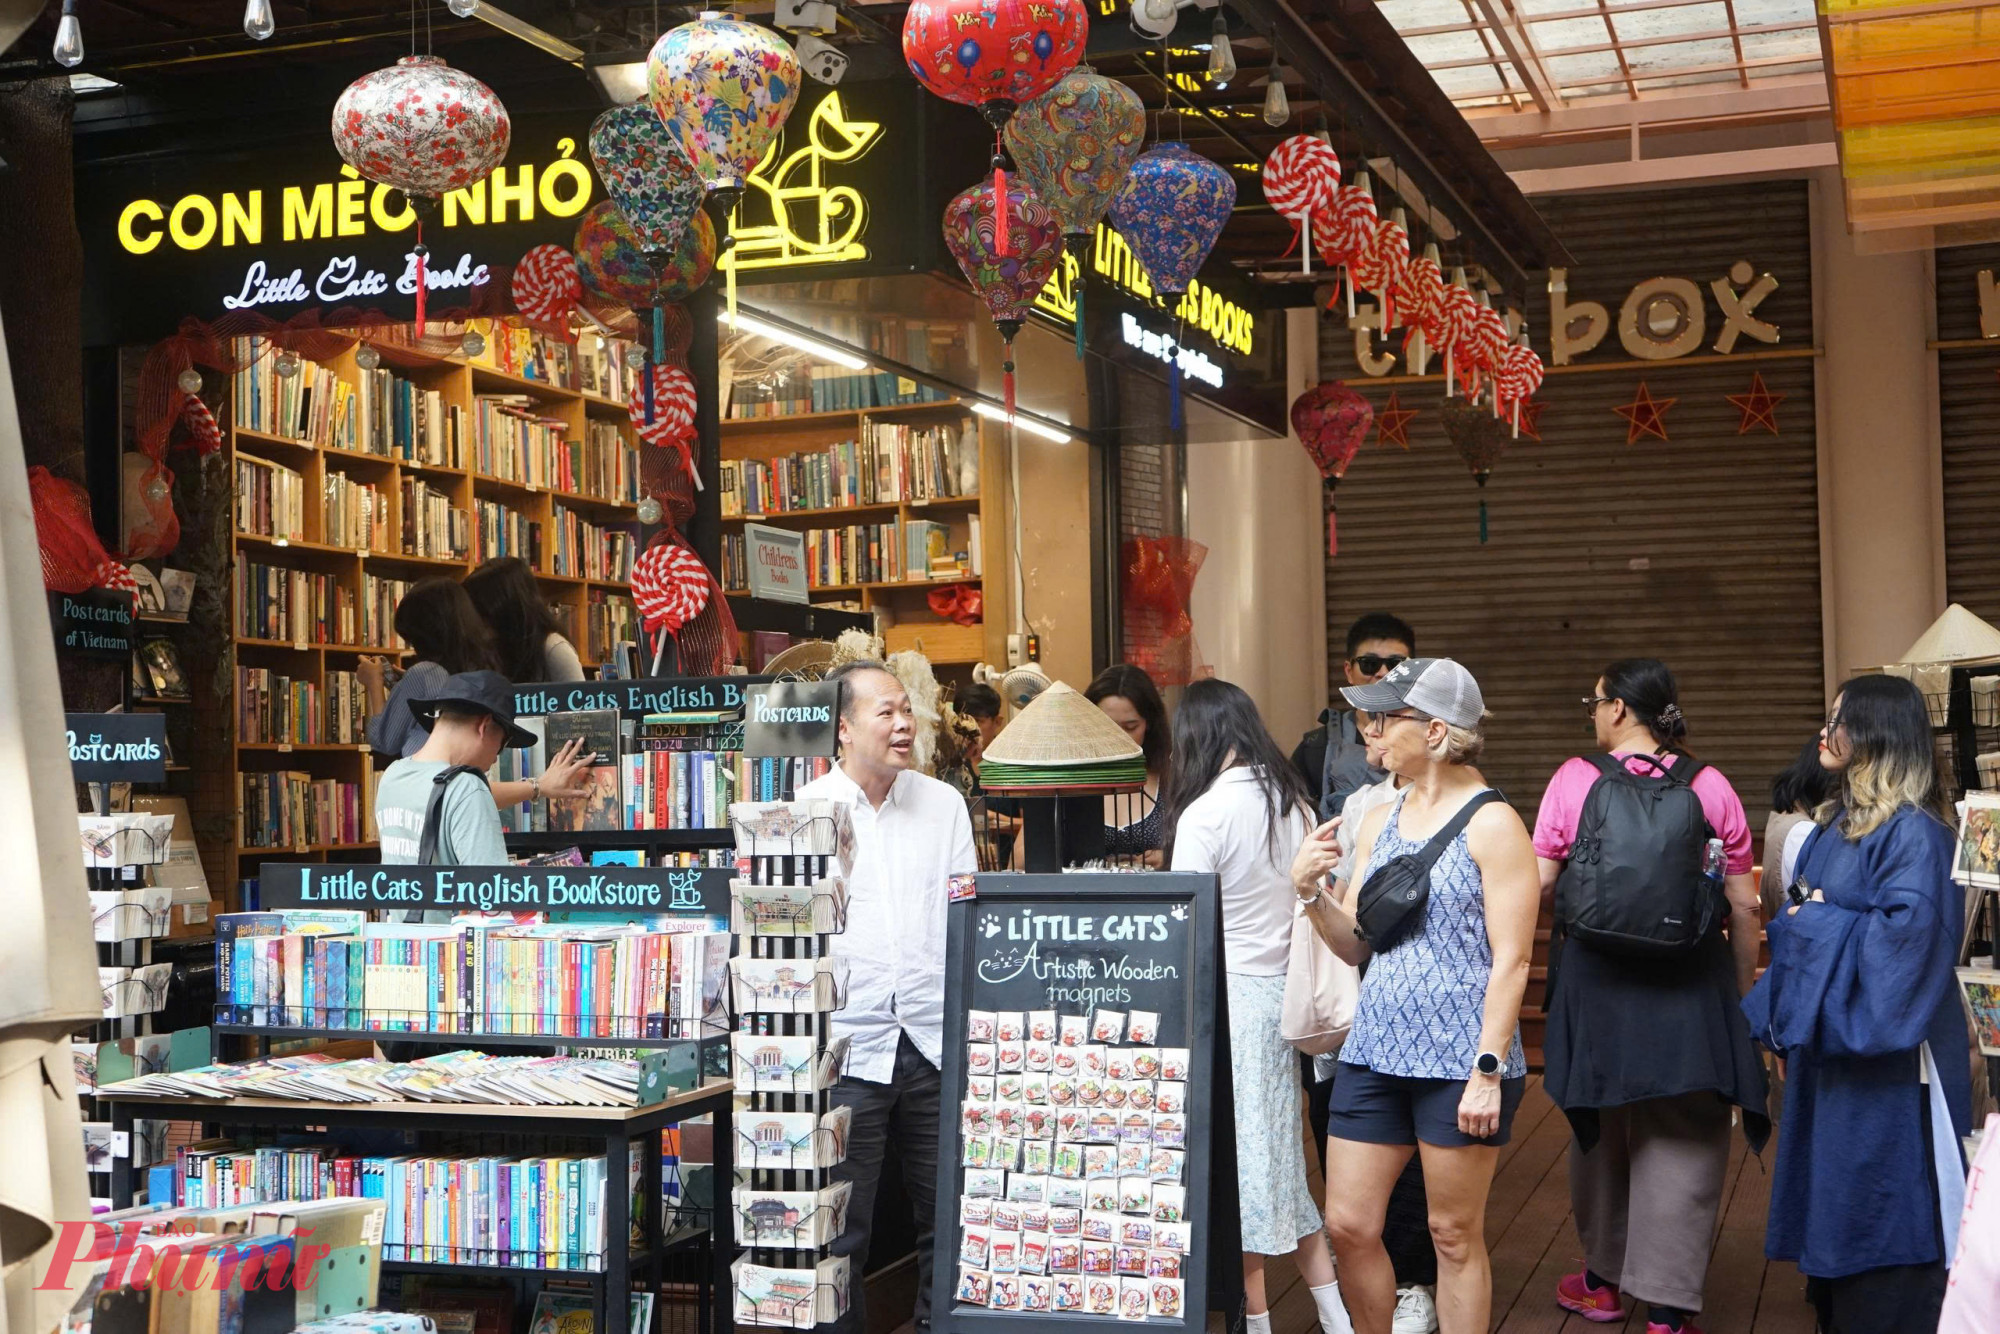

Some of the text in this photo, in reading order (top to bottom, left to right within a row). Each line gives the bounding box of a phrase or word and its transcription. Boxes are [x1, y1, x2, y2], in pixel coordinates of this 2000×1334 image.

[117, 137, 592, 254] CON MÈO NHỎ
[223, 252, 490, 309] Little Cats Books
[1201, 286, 1254, 355] BOOKS
[771, 570, 790, 585] Books
[62, 598, 130, 625] Postcards
[65, 631, 128, 650] of Vietnam
[514, 690, 558, 714] ittle
[567, 689, 618, 712] Cats
[628, 684, 715, 714] English
[383, 807, 403, 827] HOME
[405, 809, 414, 831] IN
[300, 867, 367, 901] Little
[371, 871, 423, 901] Cats
[435, 871, 540, 911] English
[666, 921, 707, 932] Explorer
[1102, 915, 1169, 941] CATS
[1023, 941, 1178, 981] Artistic Wooden
[1046, 986, 1132, 1018] magnets
